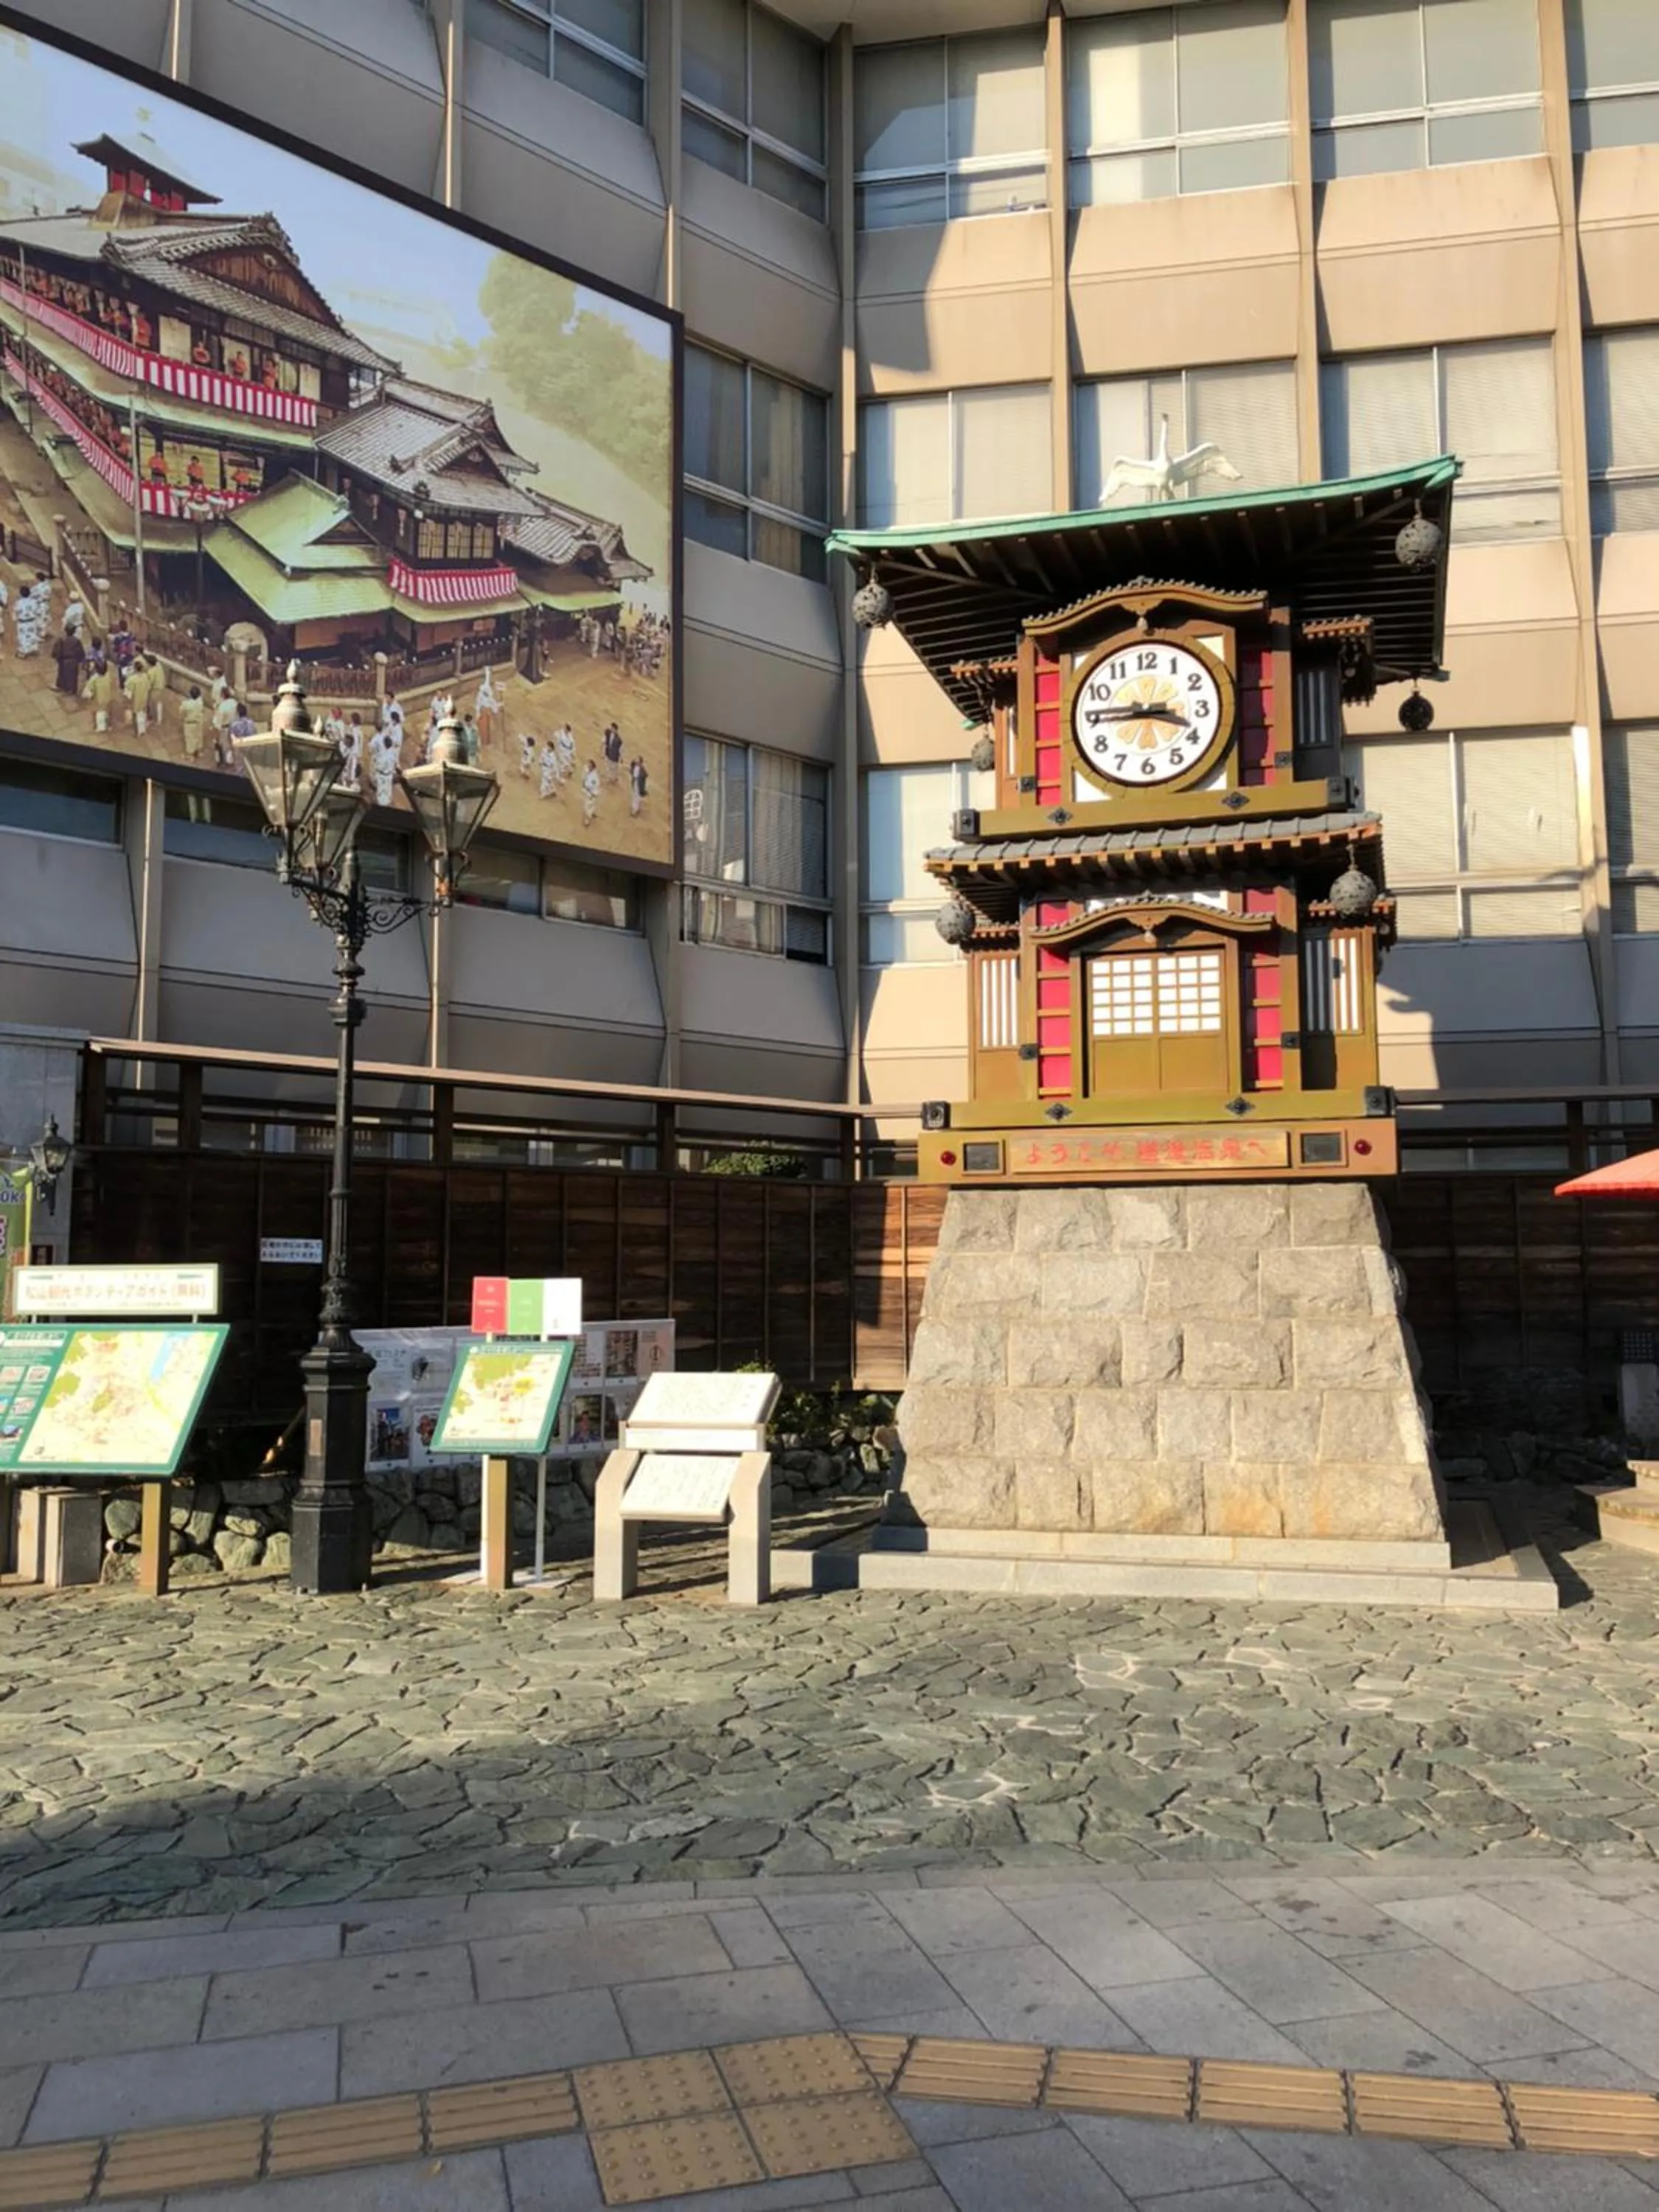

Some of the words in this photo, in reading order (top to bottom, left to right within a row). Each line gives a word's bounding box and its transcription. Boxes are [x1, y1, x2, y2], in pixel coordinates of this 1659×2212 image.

[1137, 652, 1158, 671] 12
[1169, 657, 1178, 675] 1
[1110, 661, 1127, 680] 11
[1188, 673, 1202, 692] 2
[1088, 684, 1111, 701] 10
[1194, 700, 1210, 718] 3
[1086, 712, 1099, 728] 9
[1094, 735, 1109, 753] 8
[1185, 728, 1200, 745] 4
[1114, 754, 1127, 771] 7
[1169, 748, 1184, 765] 5
[1141, 758, 1156, 775] 6
